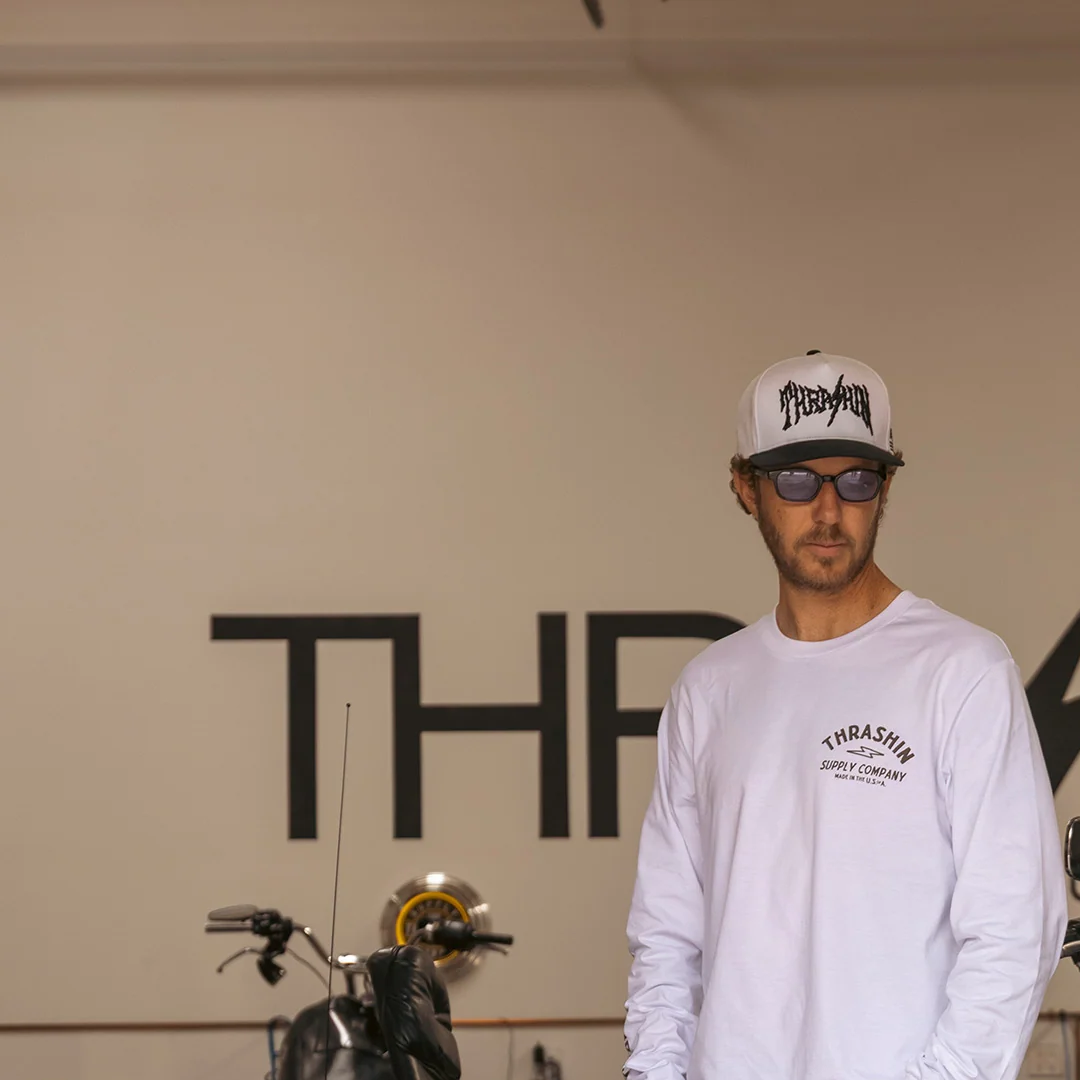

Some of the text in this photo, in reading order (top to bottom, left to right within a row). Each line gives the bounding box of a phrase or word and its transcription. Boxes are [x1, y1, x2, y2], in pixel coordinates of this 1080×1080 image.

[821, 724, 915, 764] THRASHIN
[820, 760, 907, 782] SUPPLY COMPANY
